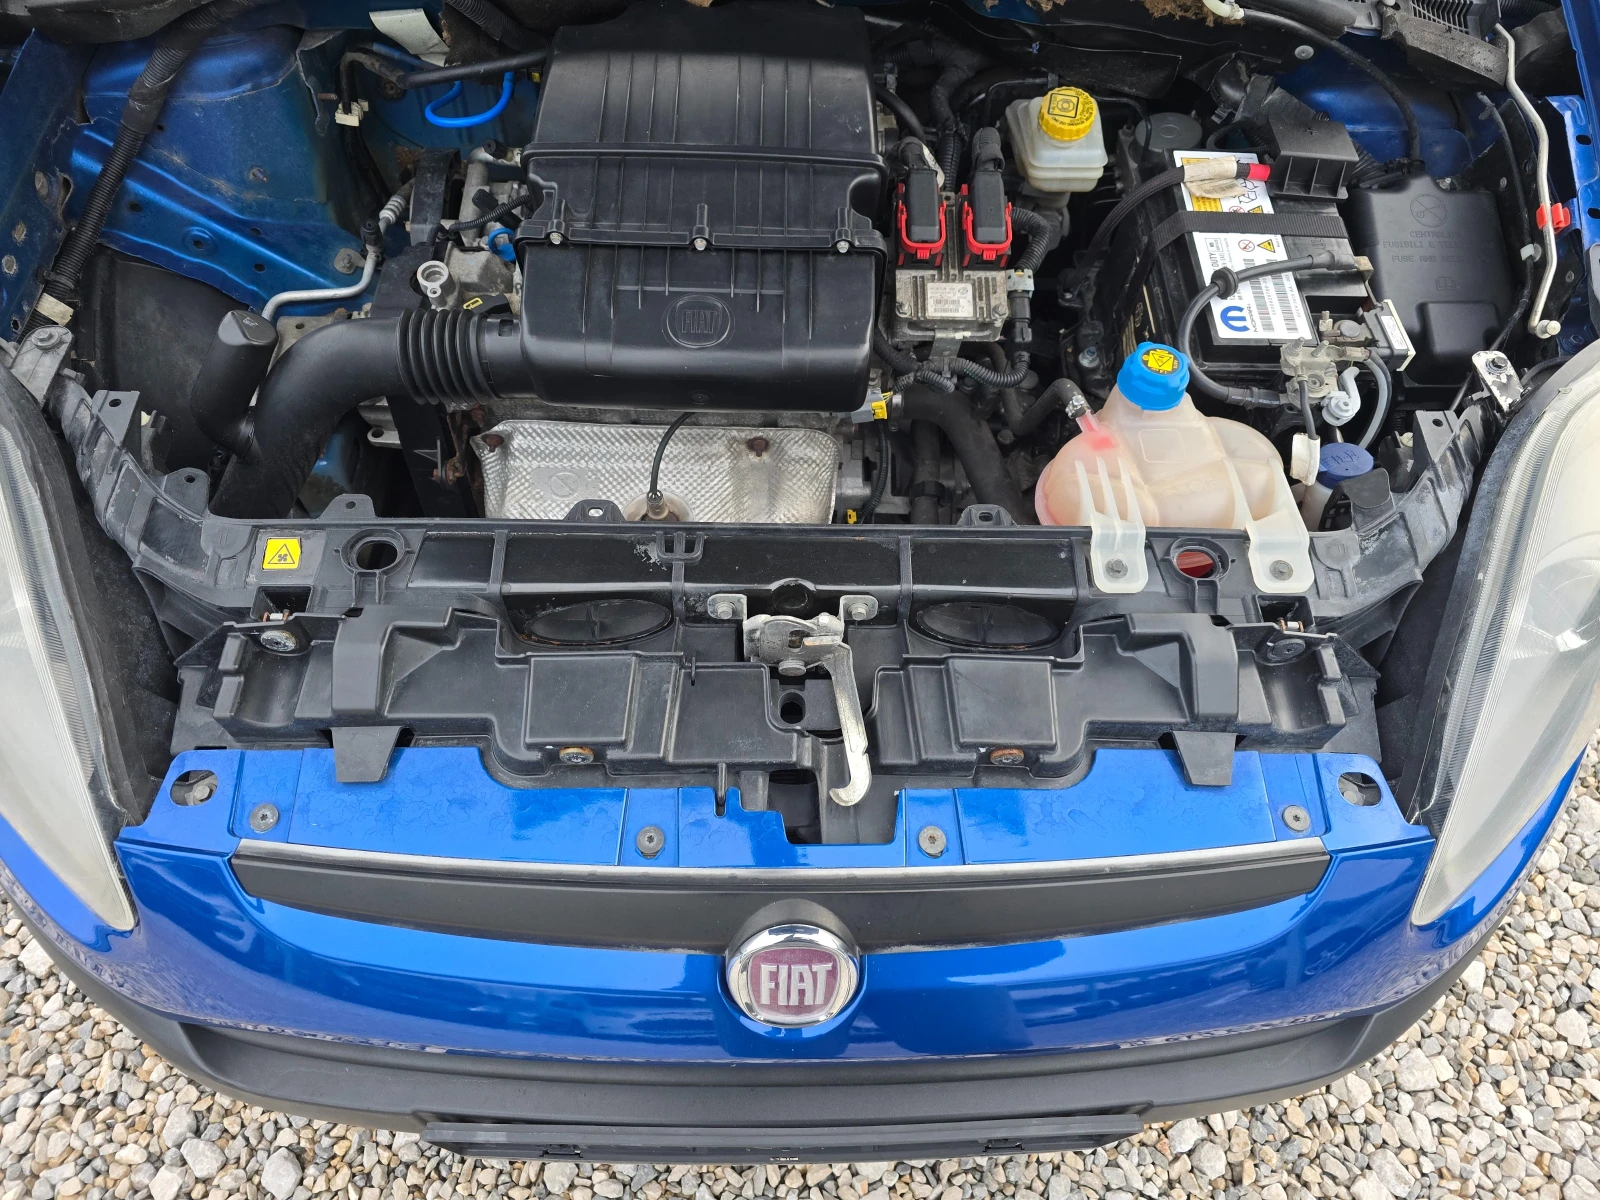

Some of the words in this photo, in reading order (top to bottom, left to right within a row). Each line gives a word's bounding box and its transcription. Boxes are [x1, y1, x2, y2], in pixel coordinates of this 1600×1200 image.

[1209, 252, 1220, 268] DUTY
[681, 309, 718, 334] FIAT
[1246, 306, 1259, 332] MOPAR
[760, 962, 834, 1006] FIAT
